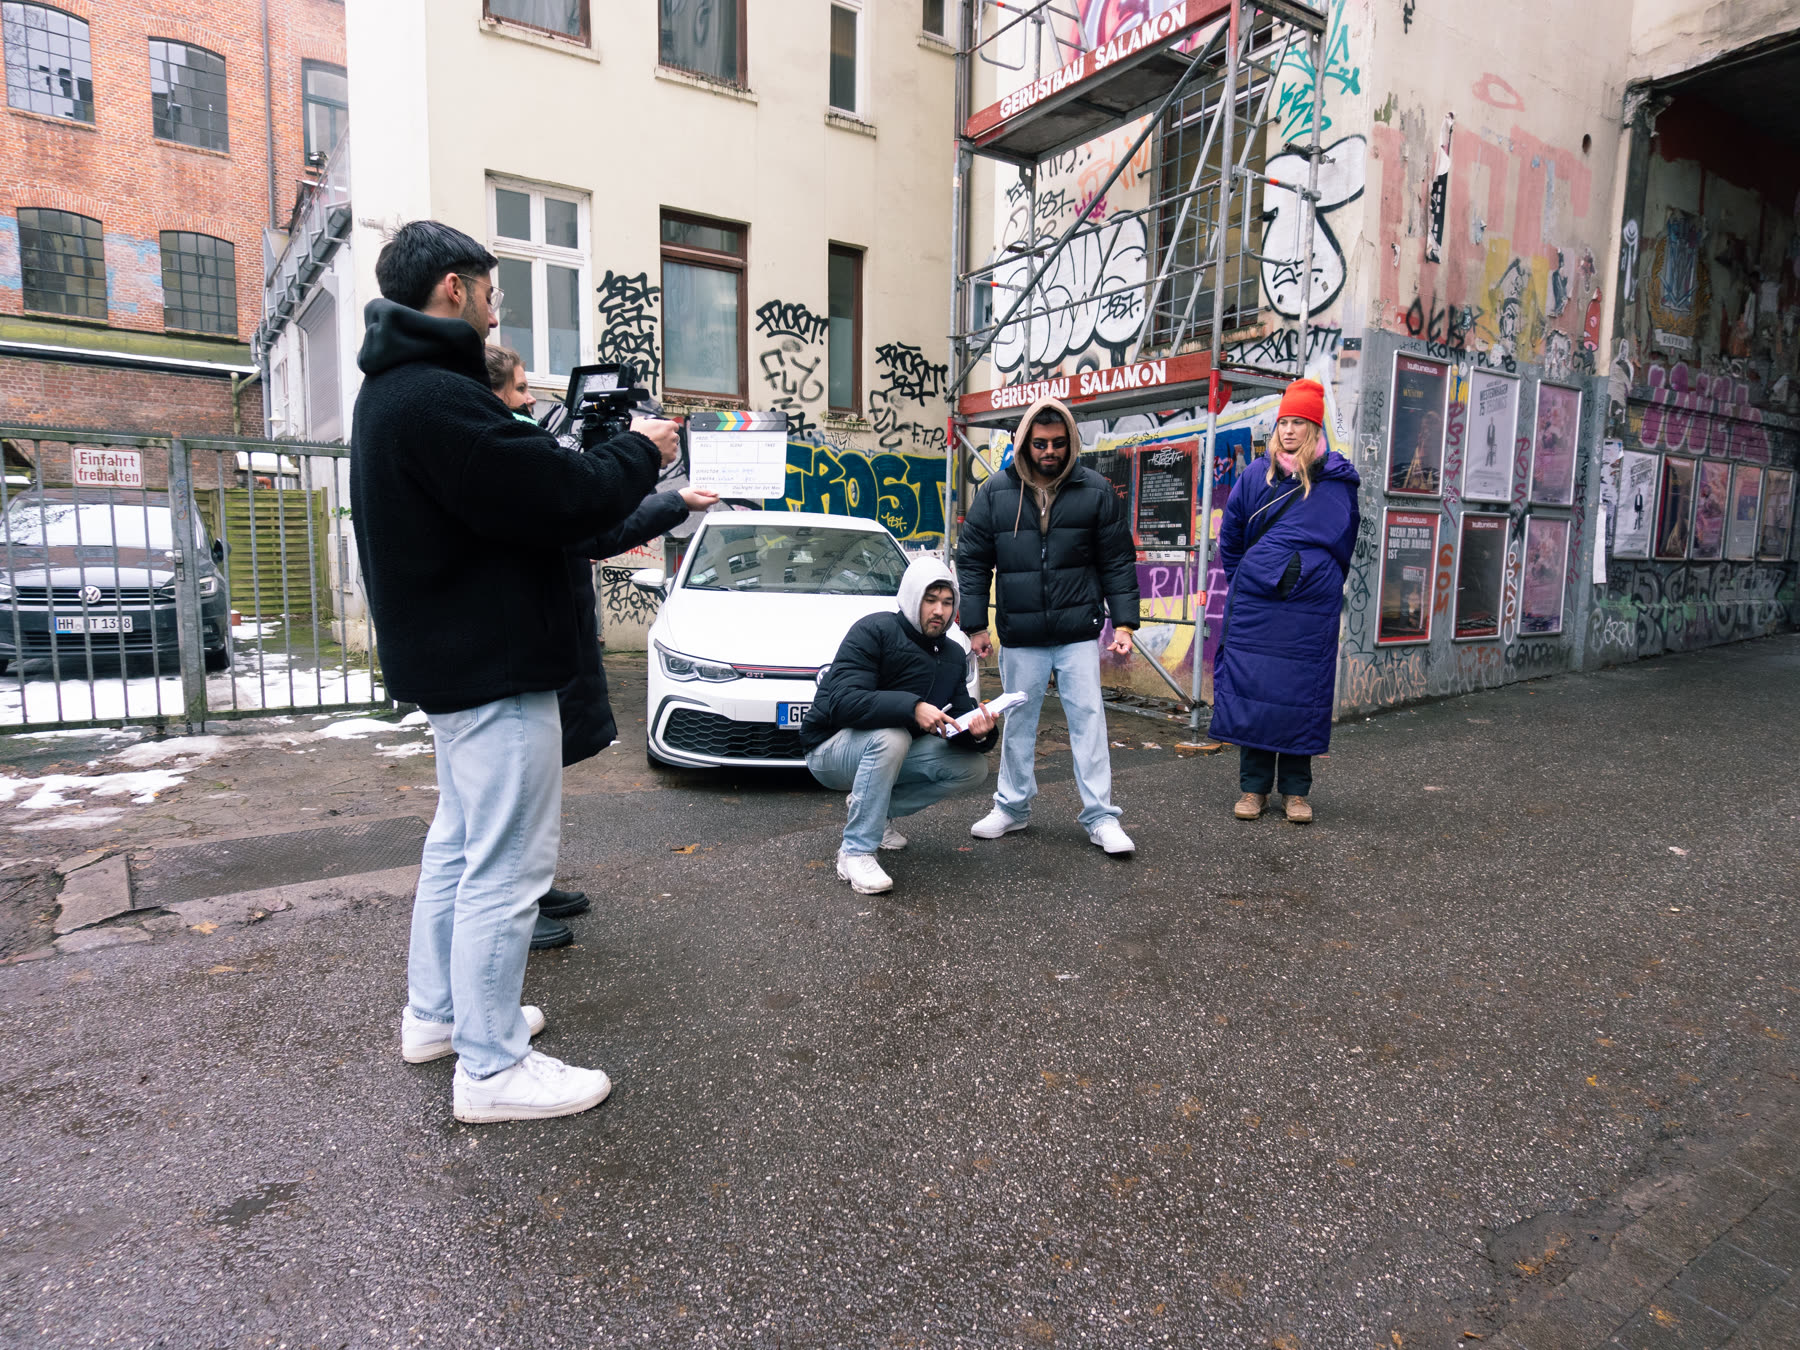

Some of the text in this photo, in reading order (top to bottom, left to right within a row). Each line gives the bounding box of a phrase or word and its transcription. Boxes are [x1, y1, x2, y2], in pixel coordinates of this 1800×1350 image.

[1000, 2, 1187, 118] GERÜSTBAU SALAMON
[991, 378, 1070, 409] GERÜSTBAU
[1080, 360, 1167, 396] SALAMON
[79, 452, 135, 467] Einfahrt
[78, 468, 139, 483] freihalten
[1387, 549, 1398, 560] IST
[58, 618, 74, 630] HH
